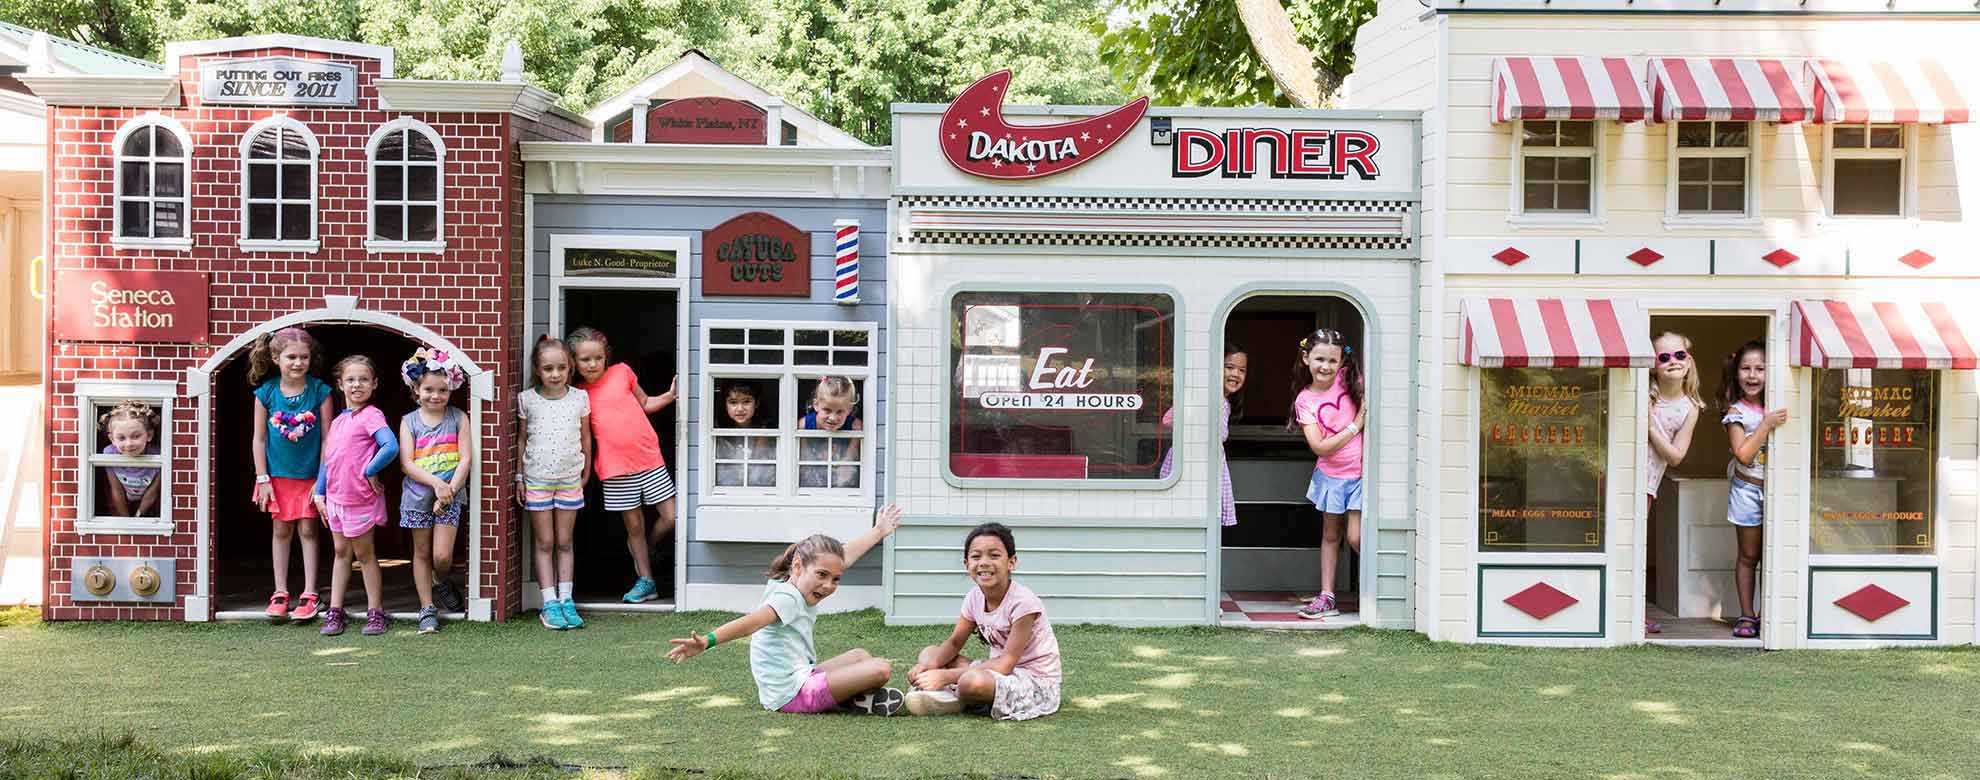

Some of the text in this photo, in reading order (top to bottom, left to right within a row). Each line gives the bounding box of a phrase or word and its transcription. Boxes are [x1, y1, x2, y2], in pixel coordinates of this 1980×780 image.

[216, 70, 342, 81] PUTTING OUT FIRES
[220, 81, 338, 97] SINCE 2011
[738, 117, 758, 128] NY
[967, 130, 1079, 163] DAKOTA
[1172, 128, 1381, 180] DINER
[572, 257, 592, 266] Luke
[731, 263, 783, 282] CUTS
[91, 281, 175, 305] Seneca
[93, 304, 174, 328] Station
[1029, 347, 1095, 390] Eat
[1507, 385, 1581, 400] MICMAC
[1840, 386, 1913, 400] MICMAC
[986, 395, 1136, 408] OPEN 24 HOURS
[1508, 400, 1580, 417] Market
[1839, 402, 1912, 417] Market
[1492, 423, 1585, 446] GROCERY
[1824, 426, 1915, 447] GROCERY
[1492, 509, 1593, 519] MEAT EGGS PRODUCE
[1882, 512, 1924, 521] PRODUCE
